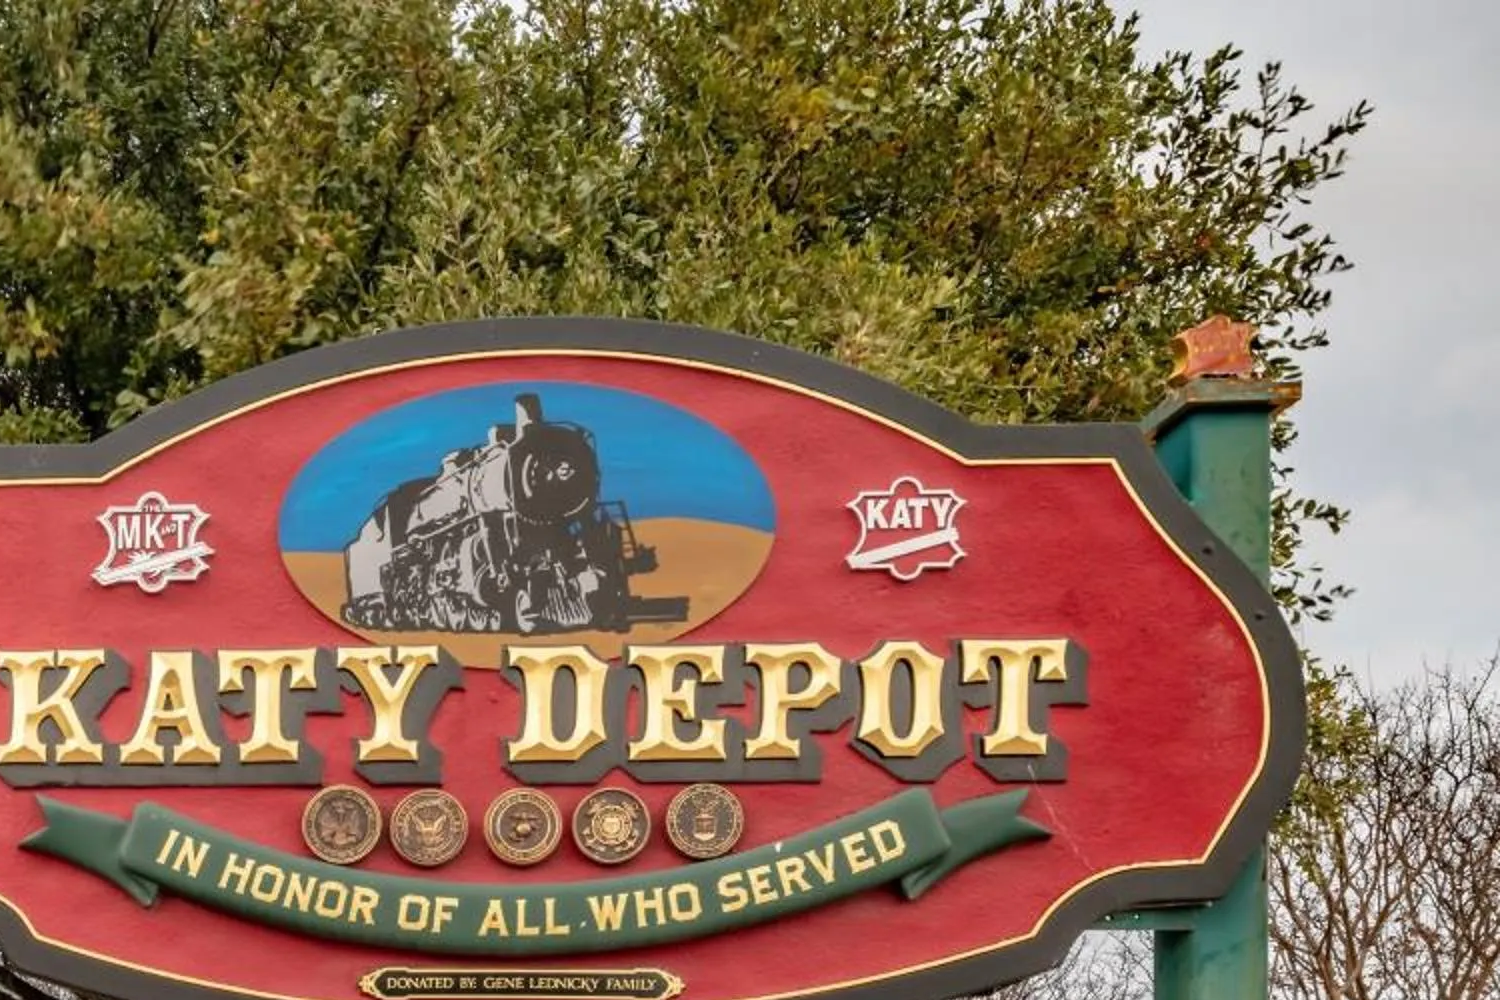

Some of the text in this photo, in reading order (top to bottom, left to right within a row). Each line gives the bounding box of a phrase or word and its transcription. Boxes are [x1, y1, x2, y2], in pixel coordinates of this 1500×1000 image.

[866, 497, 953, 529] KATY
[507, 638, 1068, 762] DEPOT
[155, 829, 211, 878] IN
[217, 852, 381, 926] HONOR
[397, 894, 459, 933] OF
[477, 897, 571, 937] ALL
[587, 882, 703, 931] WHO
[716, 819, 907, 913] SERVED
[386, 976, 657, 993] DONATED BY: GENE LEDNICKY FAMILY
